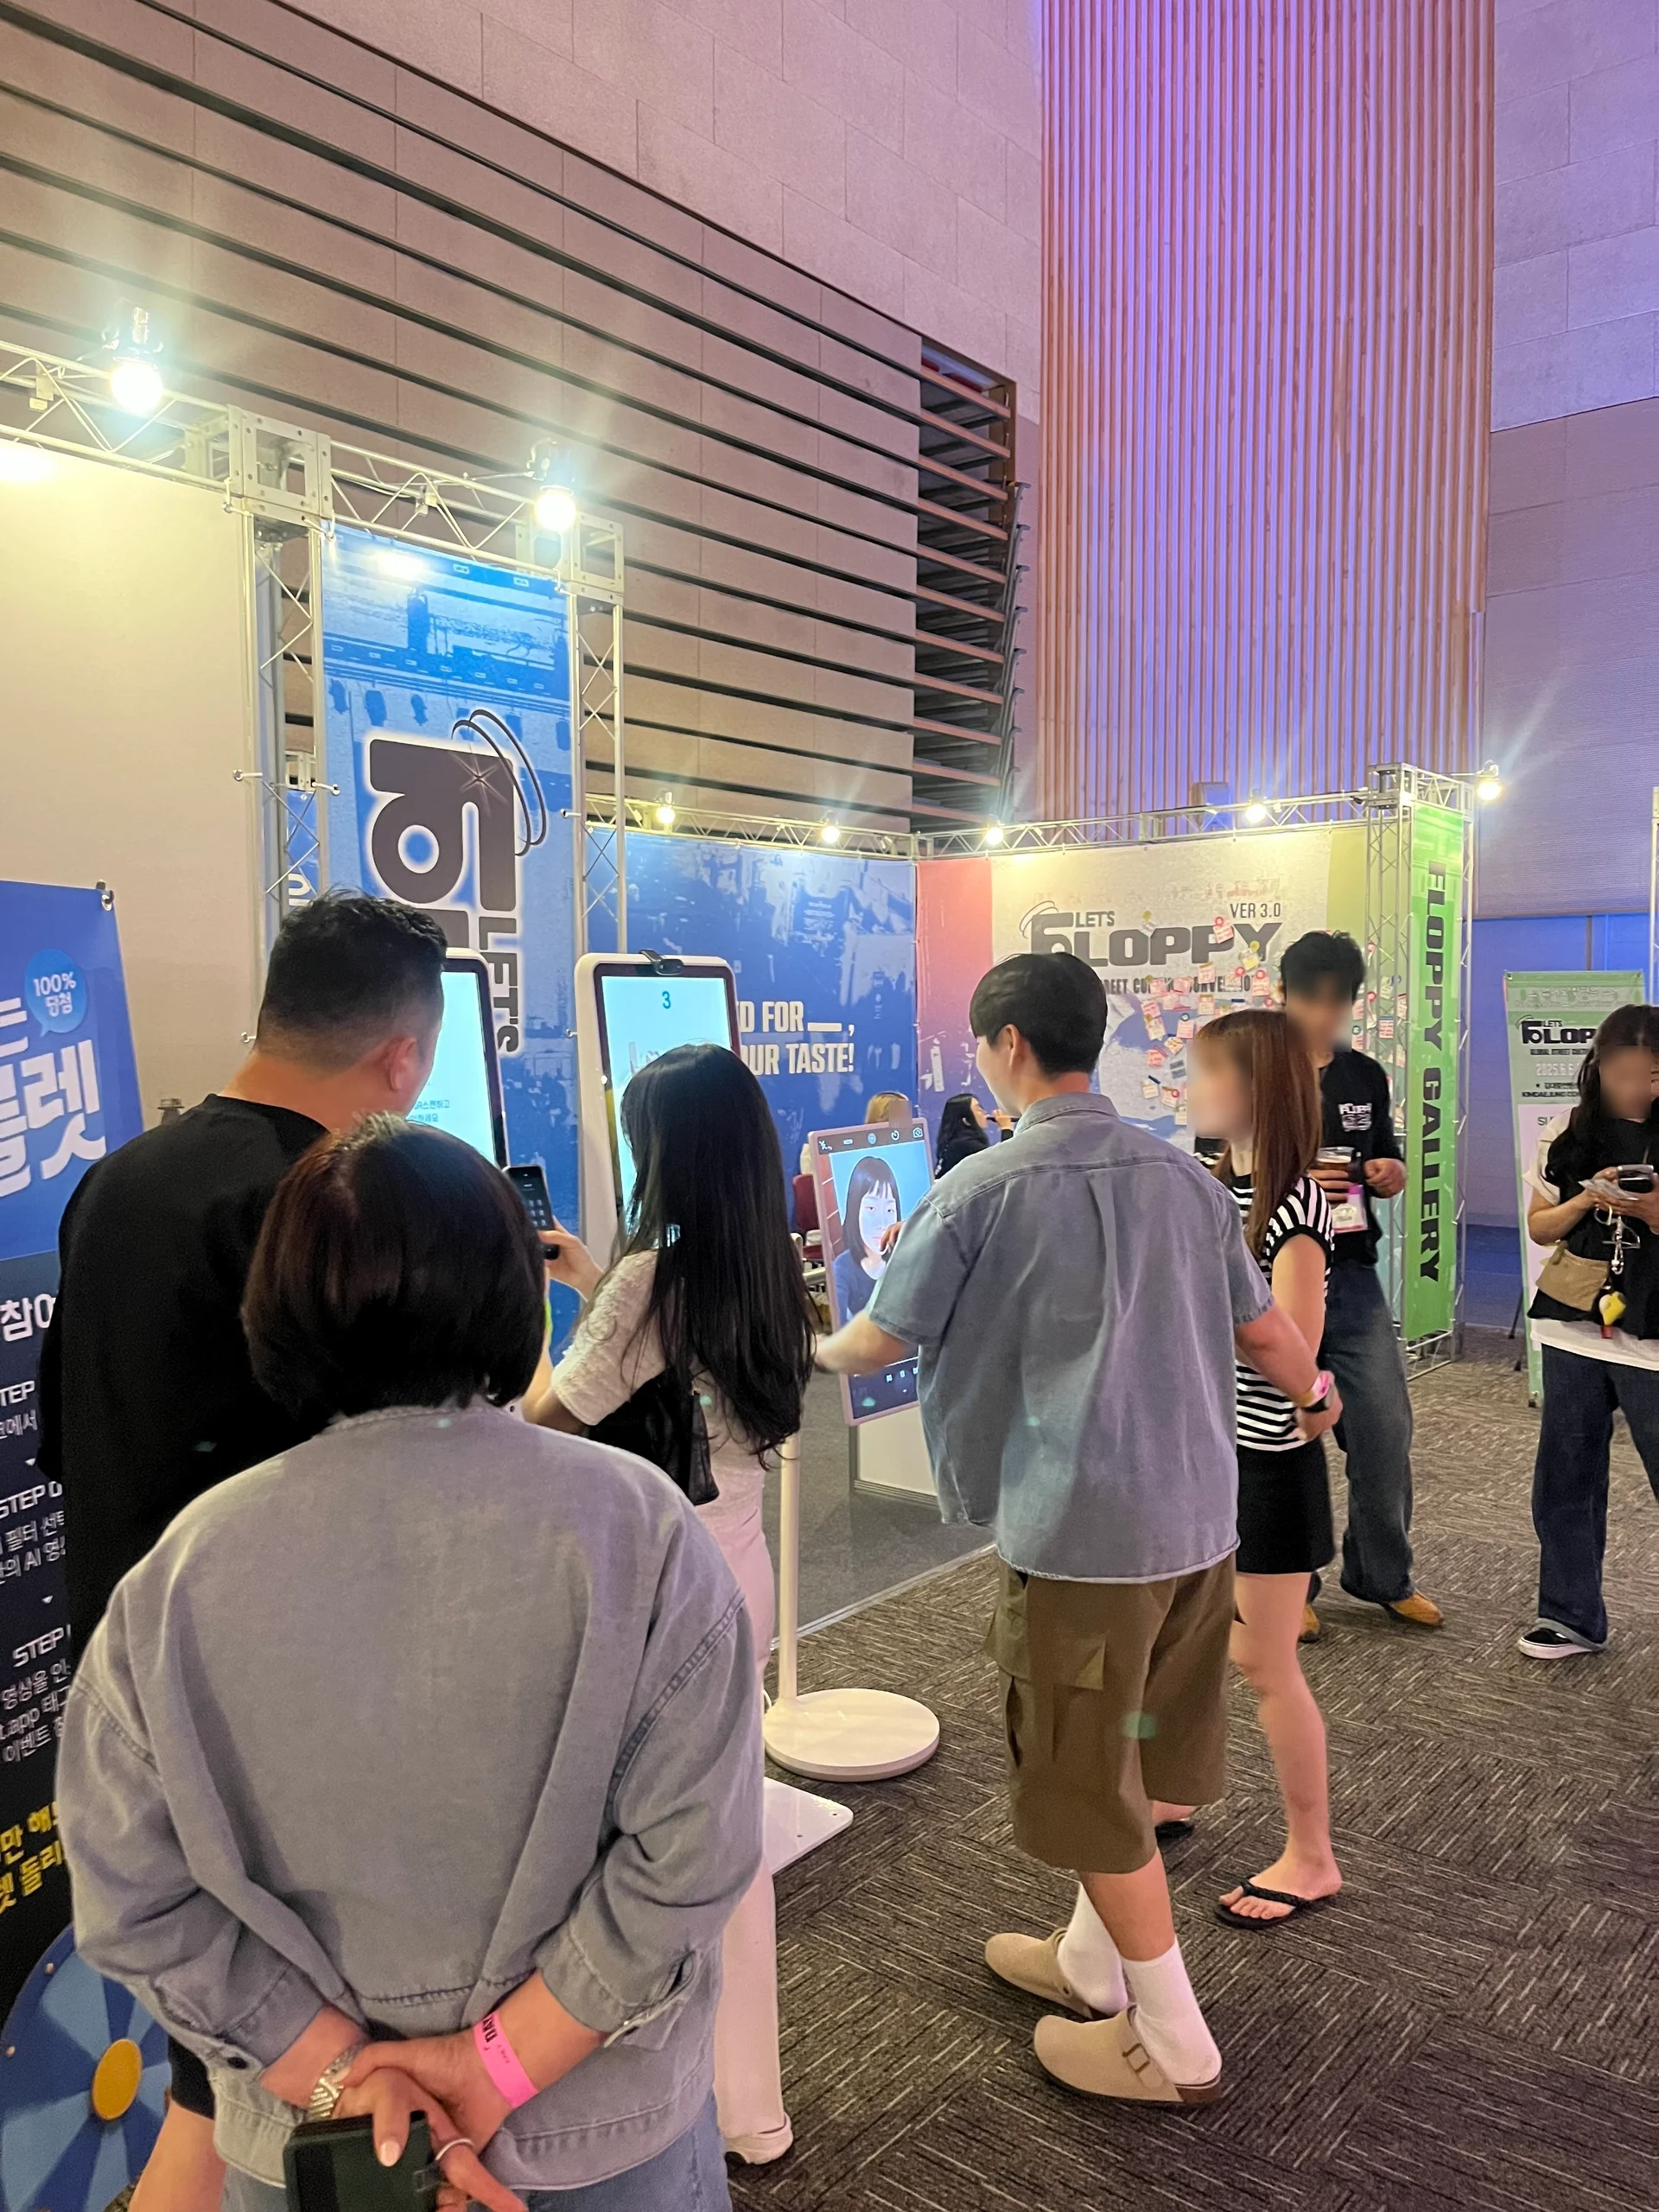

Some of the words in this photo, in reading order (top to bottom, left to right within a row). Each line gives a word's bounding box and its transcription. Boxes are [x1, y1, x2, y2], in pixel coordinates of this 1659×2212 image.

[1230, 902, 1256, 918] VER
[1260, 902, 1281, 918] 3.0
[1423, 861, 1446, 1052] FLOPPY
[33, 971, 77, 997] 100%
[662, 990, 672, 1009] 3
[762, 1001, 804, 1033] FOR
[785, 1042, 855, 1074] TASTE!
[1419, 1067, 1443, 1283] GALLERY
[23, 1548, 41, 1572] AI
[13, 1627, 65, 1668] STEP
[1, 1669, 49, 1710] 영상을
[3, 1725, 52, 1762] 이벤트
